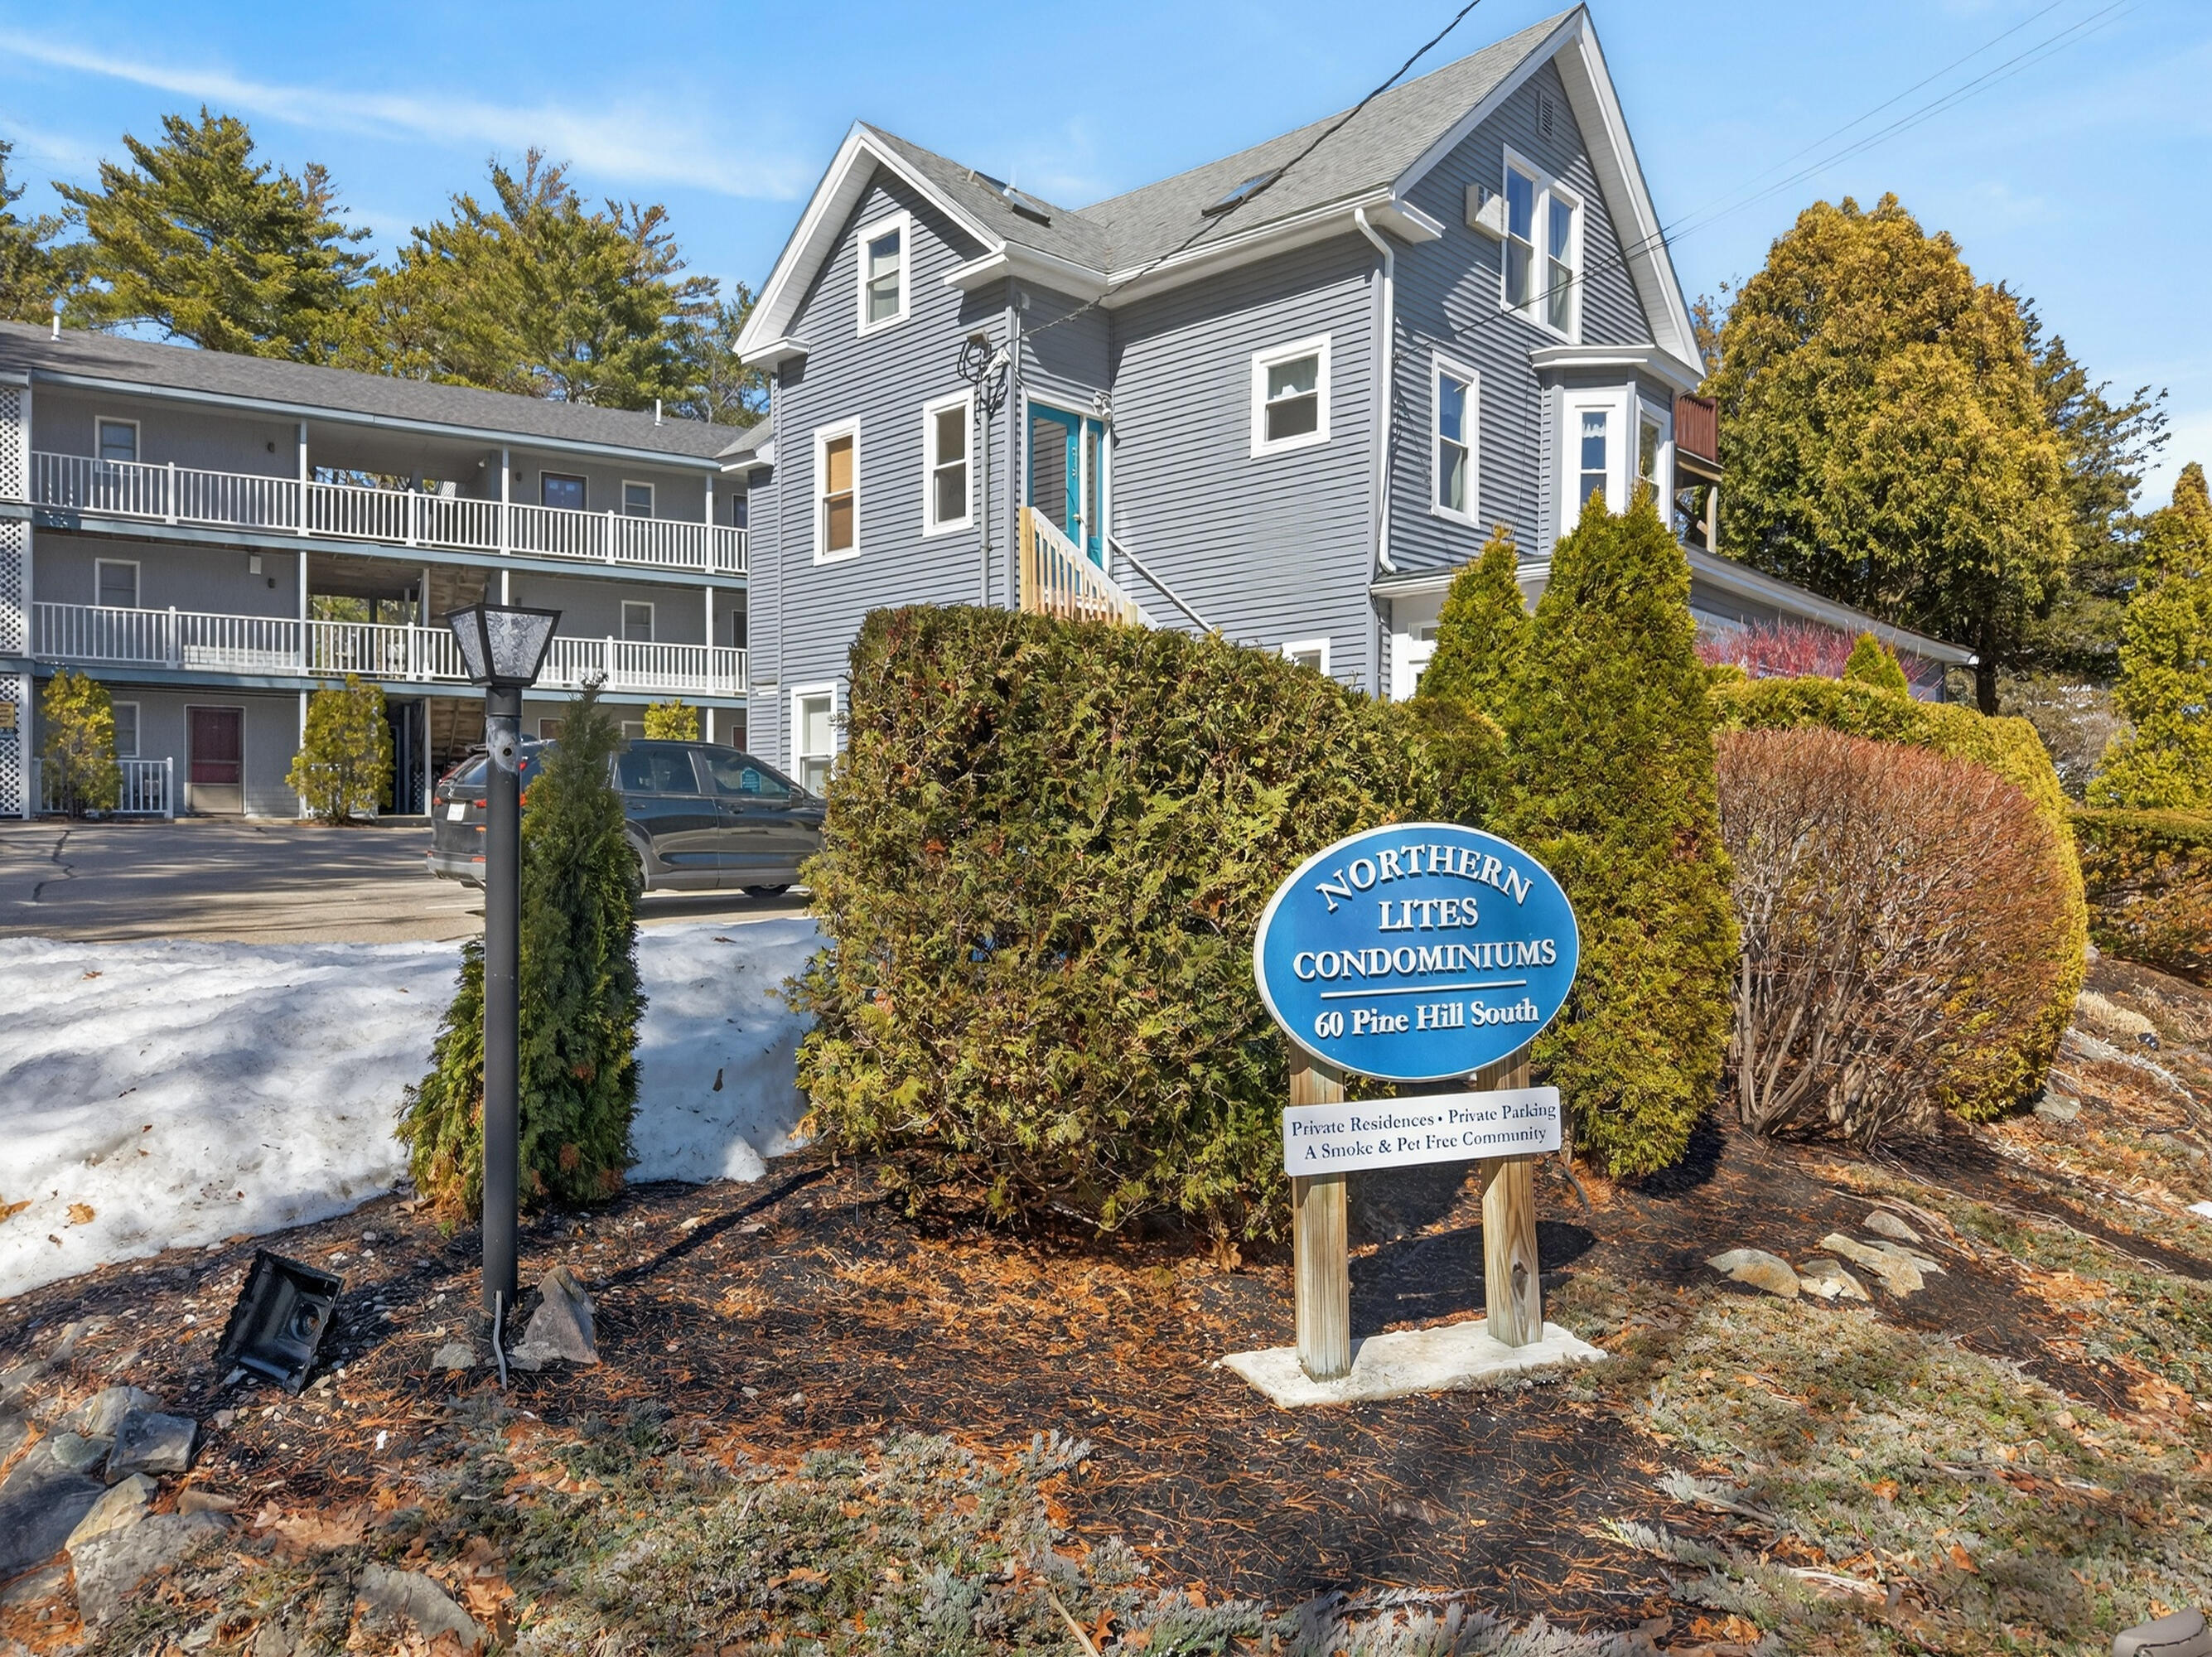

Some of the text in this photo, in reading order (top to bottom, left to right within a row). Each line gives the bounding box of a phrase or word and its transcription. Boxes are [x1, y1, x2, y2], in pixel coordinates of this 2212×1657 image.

[1316, 844, 1533, 911] NORTHERN
[1379, 897, 1479, 930] LITES
[1293, 939, 1557, 979] CONDOMINIUMS
[1315, 998, 1539, 1037] 60 Pine Hill South
[1292, 1103, 1556, 1136] Private Residences Private Parking
[1305, 1127, 1546, 1159] A Smoke & Pet Free Community
